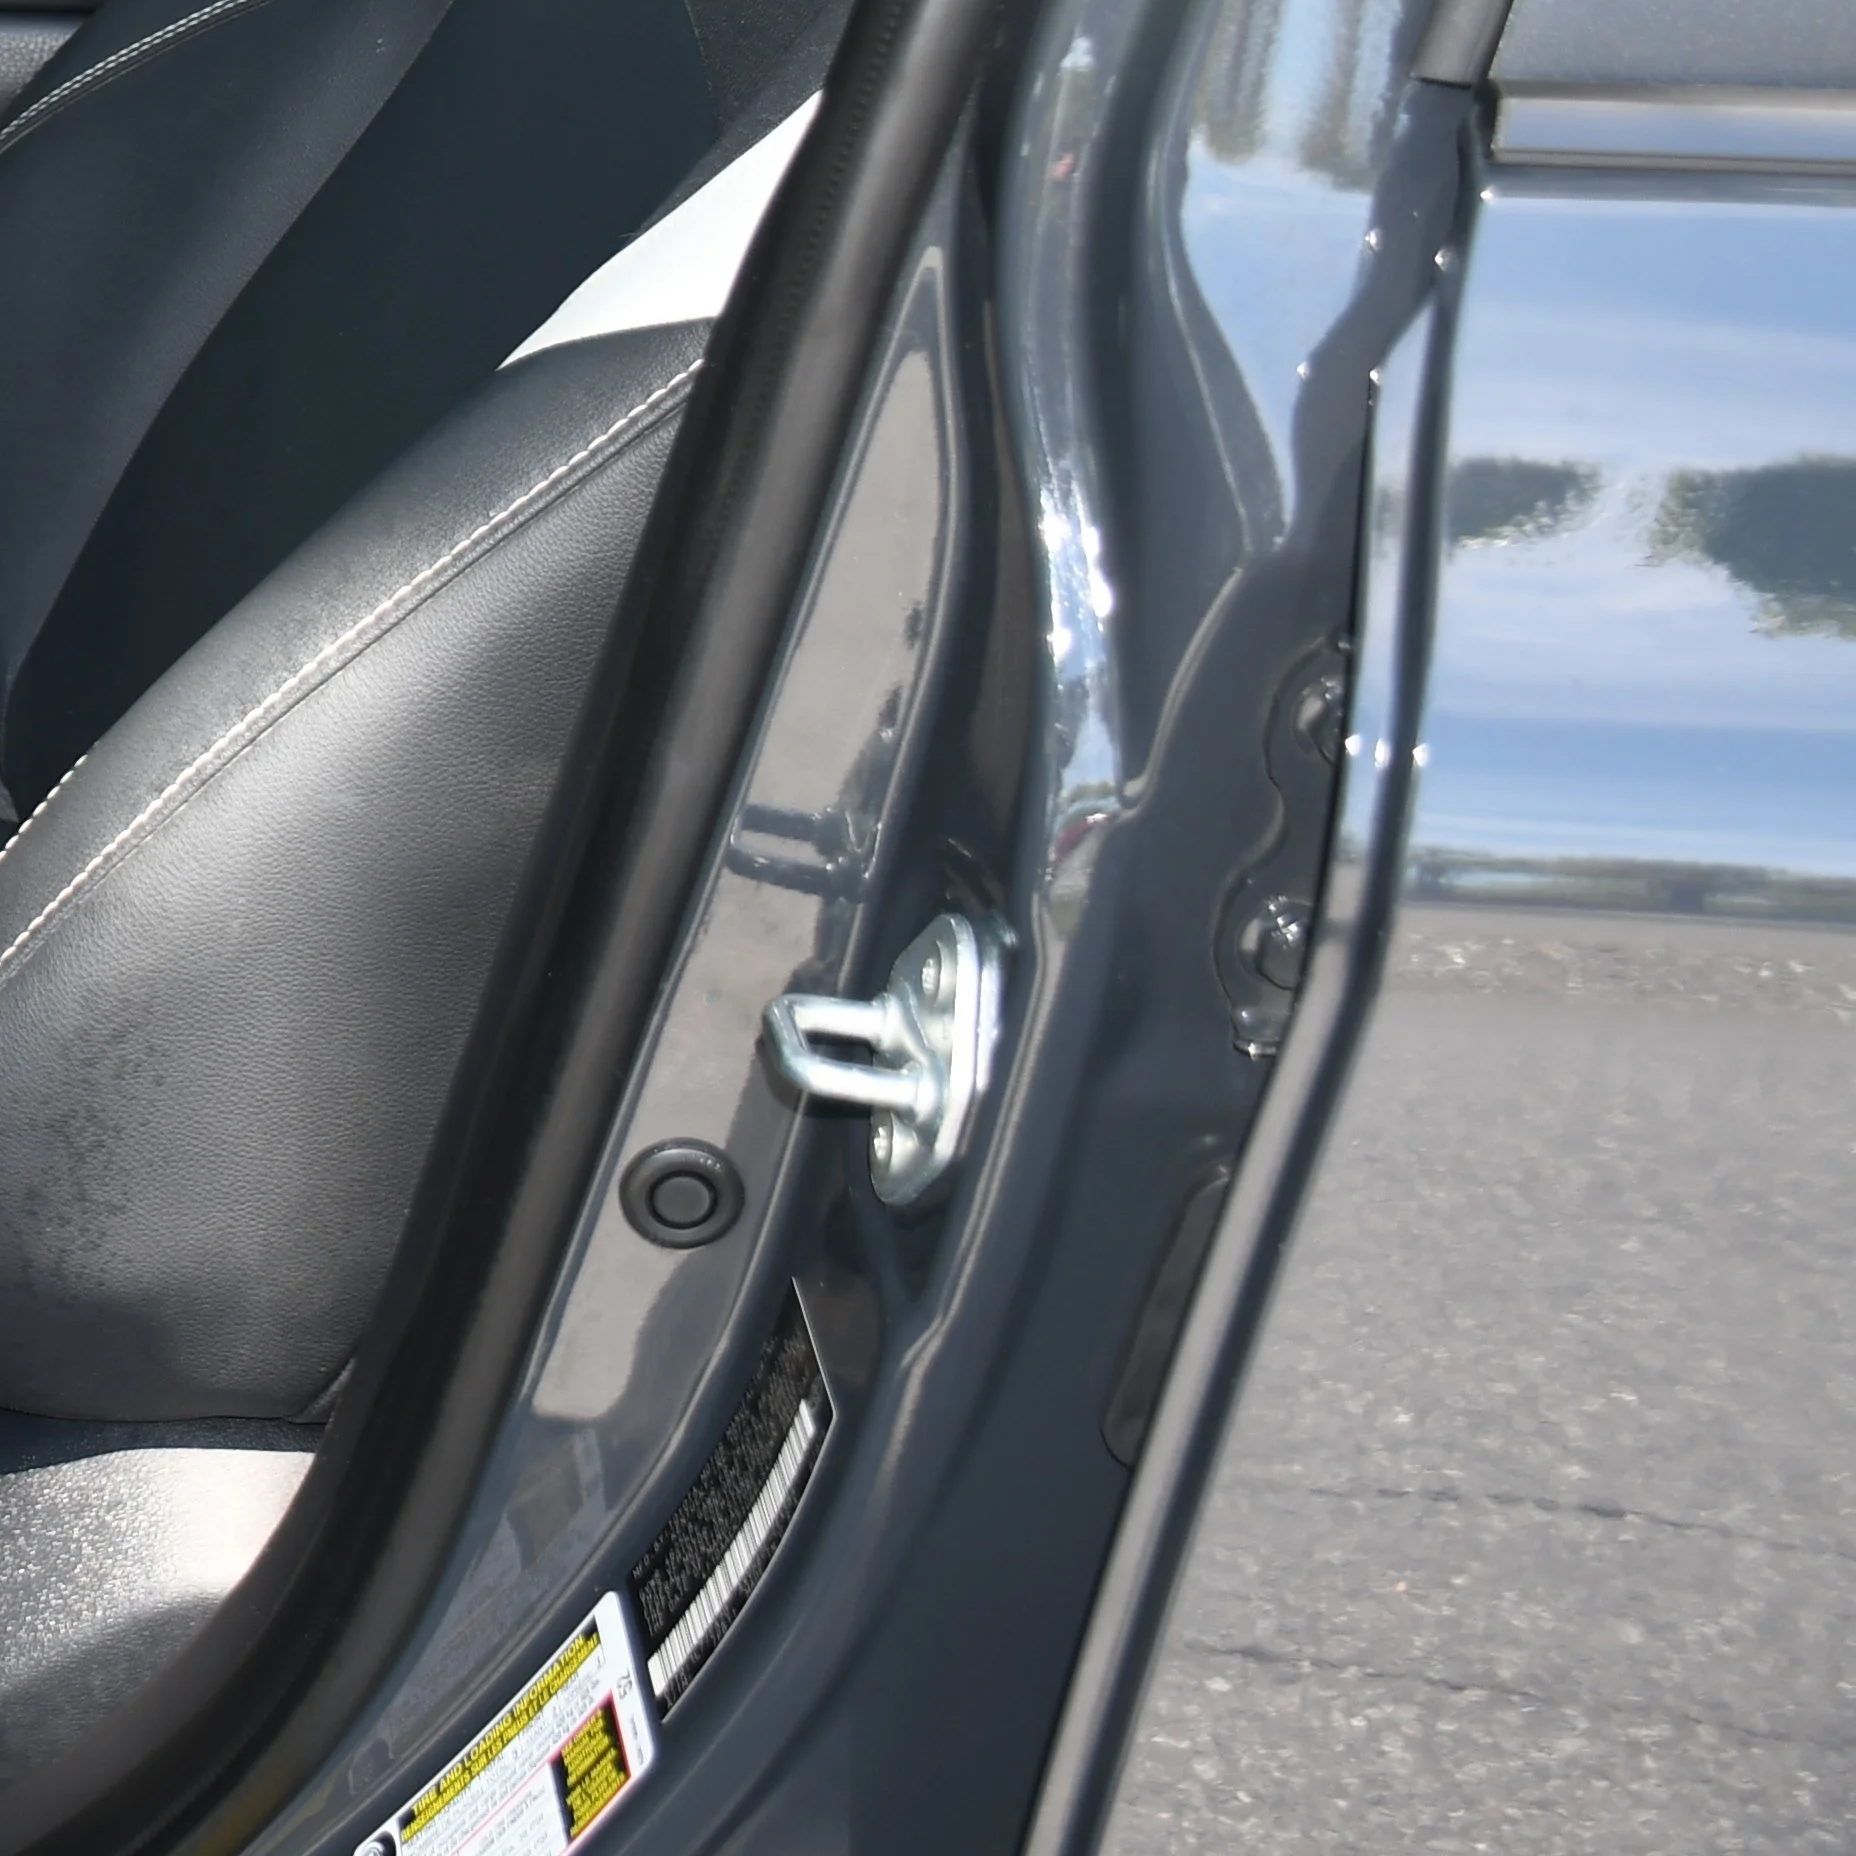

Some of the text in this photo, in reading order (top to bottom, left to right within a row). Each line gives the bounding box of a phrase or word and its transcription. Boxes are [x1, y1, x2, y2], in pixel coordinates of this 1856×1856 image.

[412, 1788, 438, 1815] TIRE
[438, 1764, 463, 1794] AND
[464, 1714, 512, 1766] LOADING
[513, 1635, 585, 1717] INFORMATION
